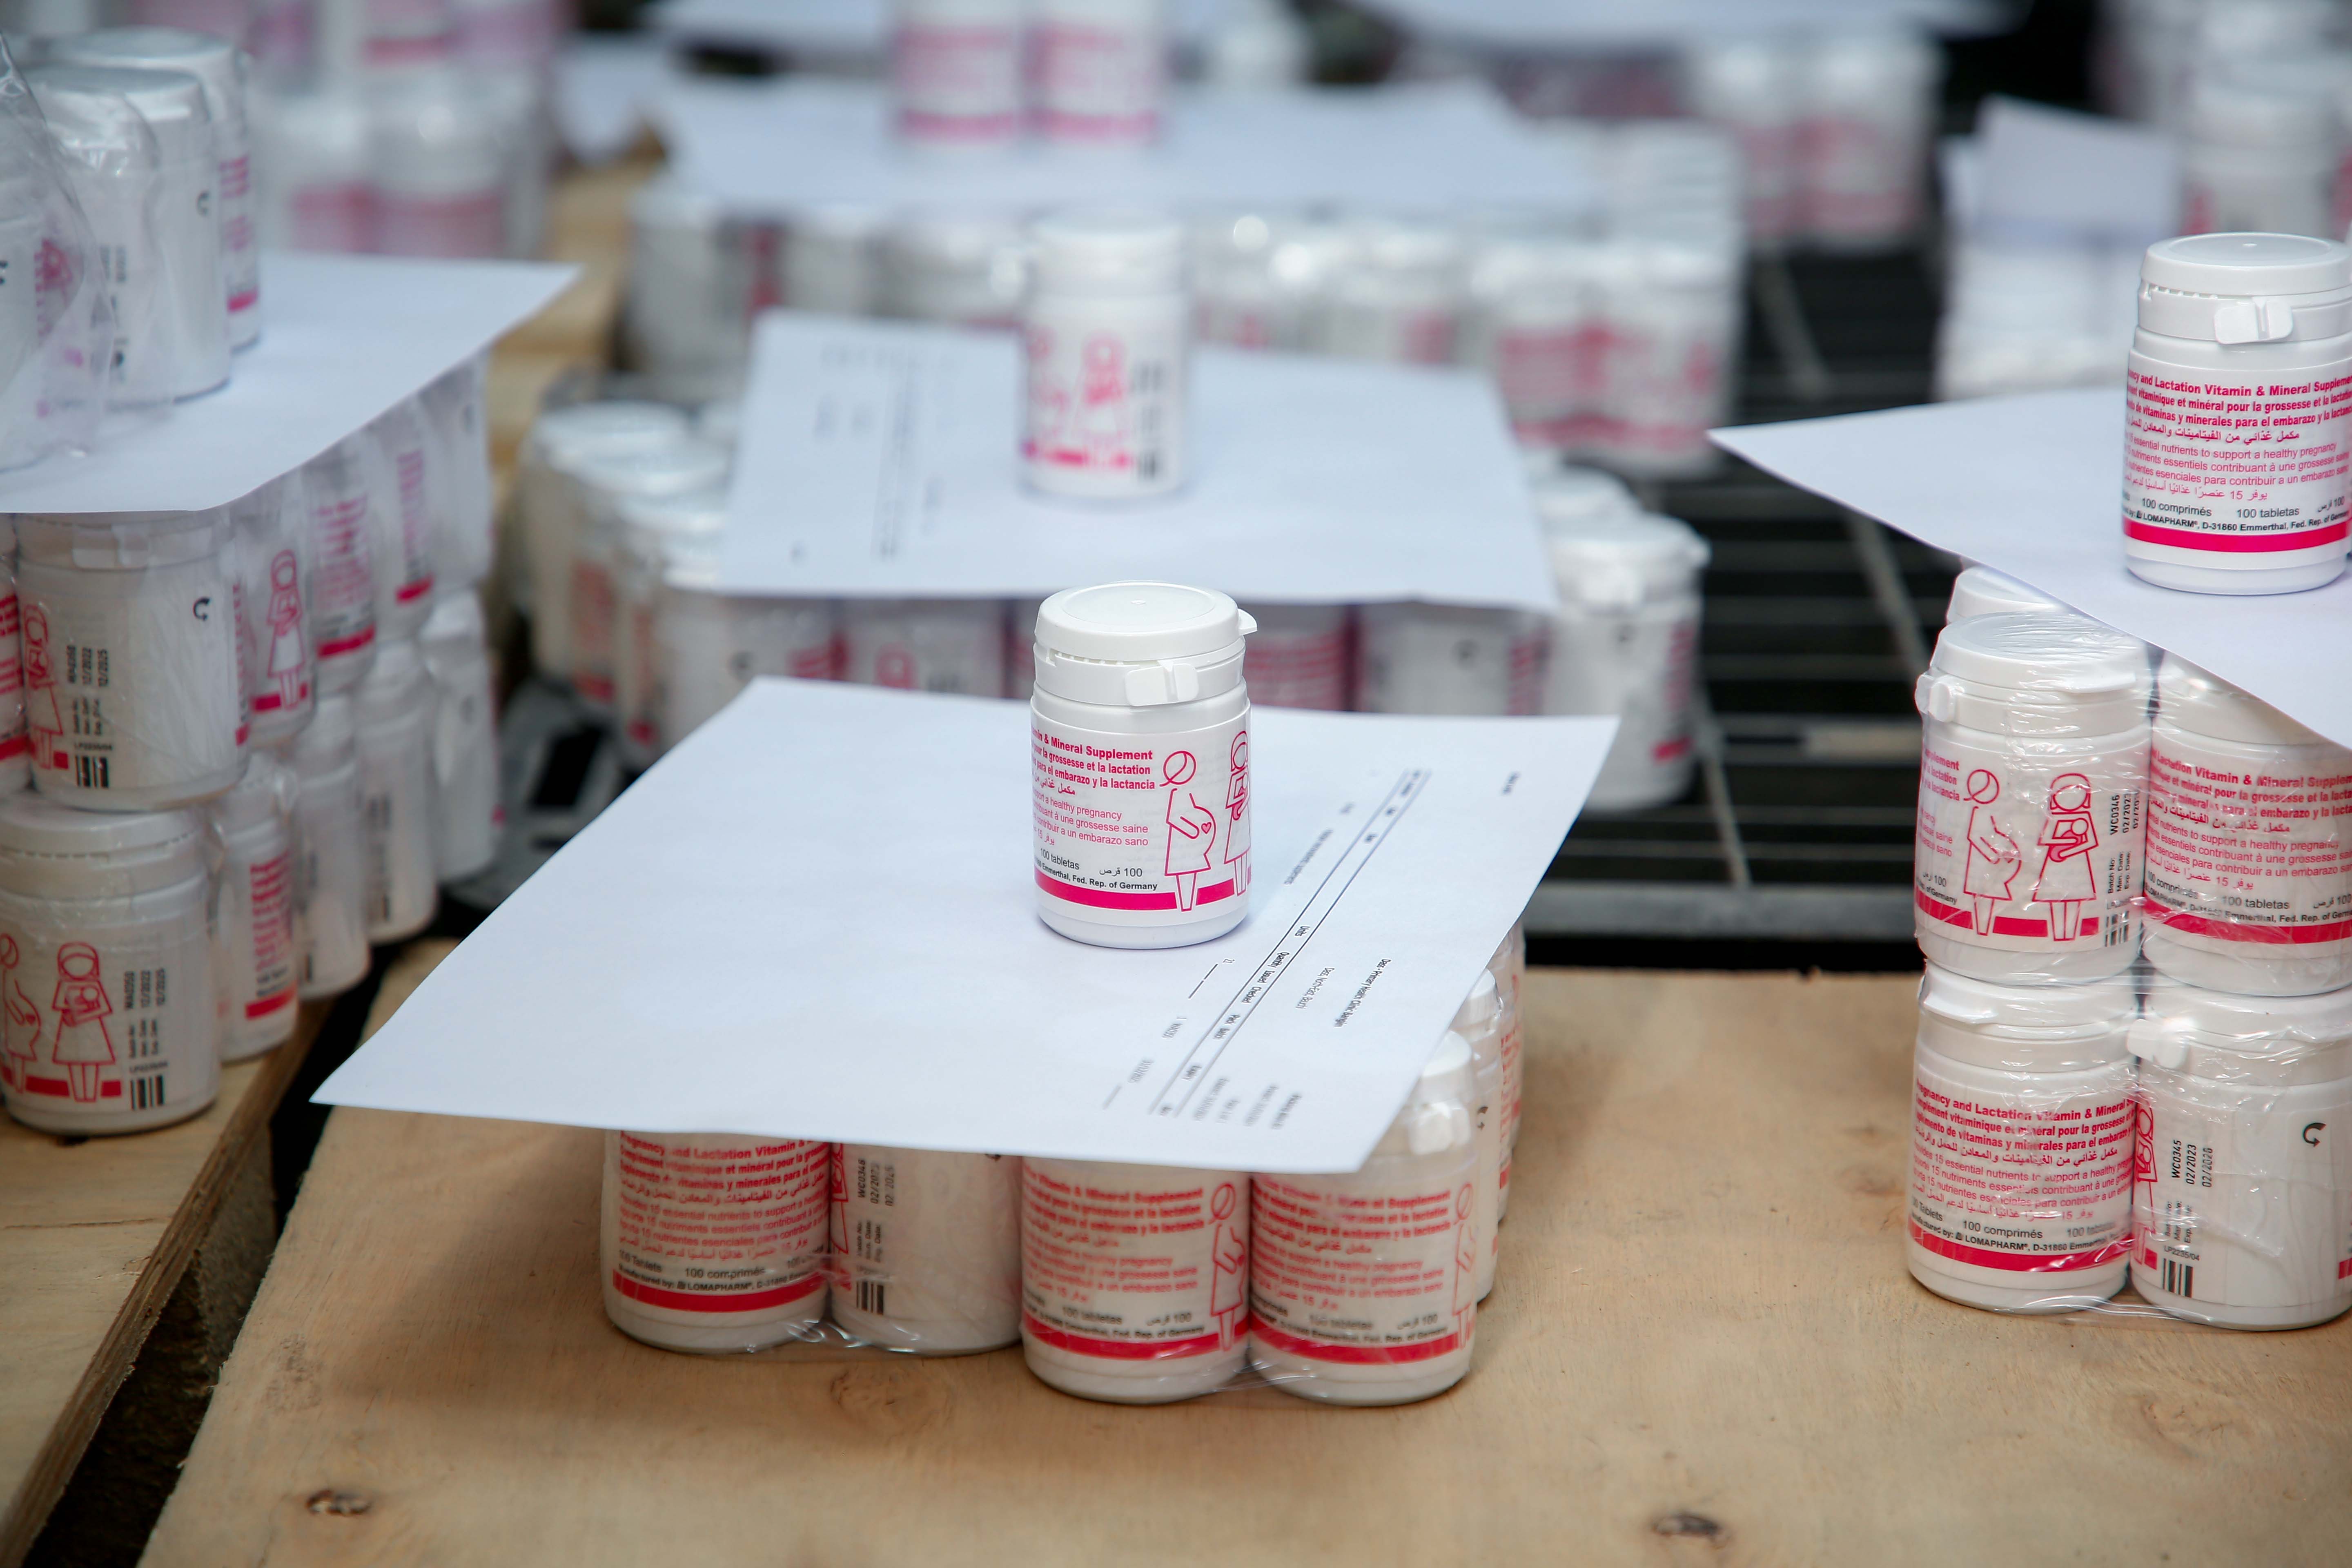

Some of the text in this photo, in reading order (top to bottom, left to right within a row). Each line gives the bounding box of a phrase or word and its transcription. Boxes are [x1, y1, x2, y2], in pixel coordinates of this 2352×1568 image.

[2155, 376, 2311, 396] Lactation Vitamin & Mineral
[2139, 388, 2321, 414] vitaminique et minéral pour la grossesse et
[2143, 405, 2316, 429] vitaminas y minerales para el embarazo
[2225, 432, 2240, 443] من
[2277, 430, 2300, 442] مكمل
[2134, 438, 2159, 450] essential
[2162, 444, 2198, 457] nutrients
[2201, 449, 2210, 457] to
[2213, 450, 2251, 461] support
[2264, 449, 2298, 459] healthy
[2300, 442, 2337, 458] pregnancy
[2164, 458, 2208, 470] essentiels
[2211, 463, 2267, 472] contribuant
[2270, 463, 2276, 472] à
[2299, 457, 2334, 471] grossesse
[2156, 470, 2201, 483] esenciales
[2204, 476, 2226, 486] para
[2230, 477, 2276, 486] contribuir
[2301, 469, 2334, 482] embarazo
[2230, 490, 2243, 500] 15
[2142, 498, 2300, 518] 100 comprimés 100 tabletas
[2202, 521, 2237, 531] D-31860
[2241, 523, 2289, 531] Emmerthal,
[2291, 520, 2306, 528] Fed.
[2309, 517, 2322, 527] Rep.
[1044, 734, 1049, 744] &
[1051, 736, 1083, 754] Mineral
[1086, 746, 1153, 761] Supplement
[1043, 747, 1151, 775] la grossesse et la lactation
[1048, 766, 1155, 789] el embarazo y la lactancia
[2196, 766, 2252, 785] Vitamin &
[2215, 787, 2249, 800] pour la
[1050, 797, 1075, 813] healthy
[1076, 806, 1122, 821] pregnancy
[2110, 795, 2120, 835] WC0346
[2261, 807, 2310, 818] embarazo
[1054, 811, 1149, 833] à une grossesse saine
[1067, 829, 1076, 838] un
[1078, 831, 1122, 845] embarazo
[1125, 838, 1149, 846] sano
[2201, 834, 2287, 853] support healthy
[1937, 845, 1952, 857] sano
[2161, 834, 2336, 866] essentiels grossesse
[1040, 848, 1080, 870] 100 tabletas
[1042, 862, 1071, 882] Emmerthal,
[1072, 875, 1087, 884] Fed.
[1089, 879, 1107, 888] Rep.
[1119, 882, 1158, 891] Germany
[1124, 868, 1143, 877] 100
[1934, 875, 1947, 887] 100
[1931, 888, 1957, 905] Germany
[2246, 898, 2290, 909] tabletas
[2301, 914, 2320, 922] Rep.
[1295, 926, 1310, 936] Units
[1268, 952, 1290, 968] Quantity
[1376, 959, 1392, 968] Dass
[1257, 970, 1275, 983] Issued
[1317, 967, 1335, 976] Dass,
[1362, 970, 1382, 986] Primary
[1241, 987, 1262, 1003] Checked
[1354, 987, 1372, 1000] Health
[1345, 1000, 1361, 1012] Clinic
[2085, 1109, 2092, 1119] &
[2096, 1099, 2125, 1117] Mineral
[2058, 1116, 2125, 1138] pour grossesse
[755, 1142, 796, 1158] Vitamin
[2066, 1137, 2096, 1152] para el
[2172, 1140, 2182, 1178] WC0345
[2186, 1144, 2196, 1185] 02/2023
[1945, 1159, 2029, 1181] essential nutrients
[1942, 1170, 2093, 1194] nutriments contribuant
[1963, 1220, 2043, 1239] 100 comprimés
[685, 1267, 704, 1278] 100
